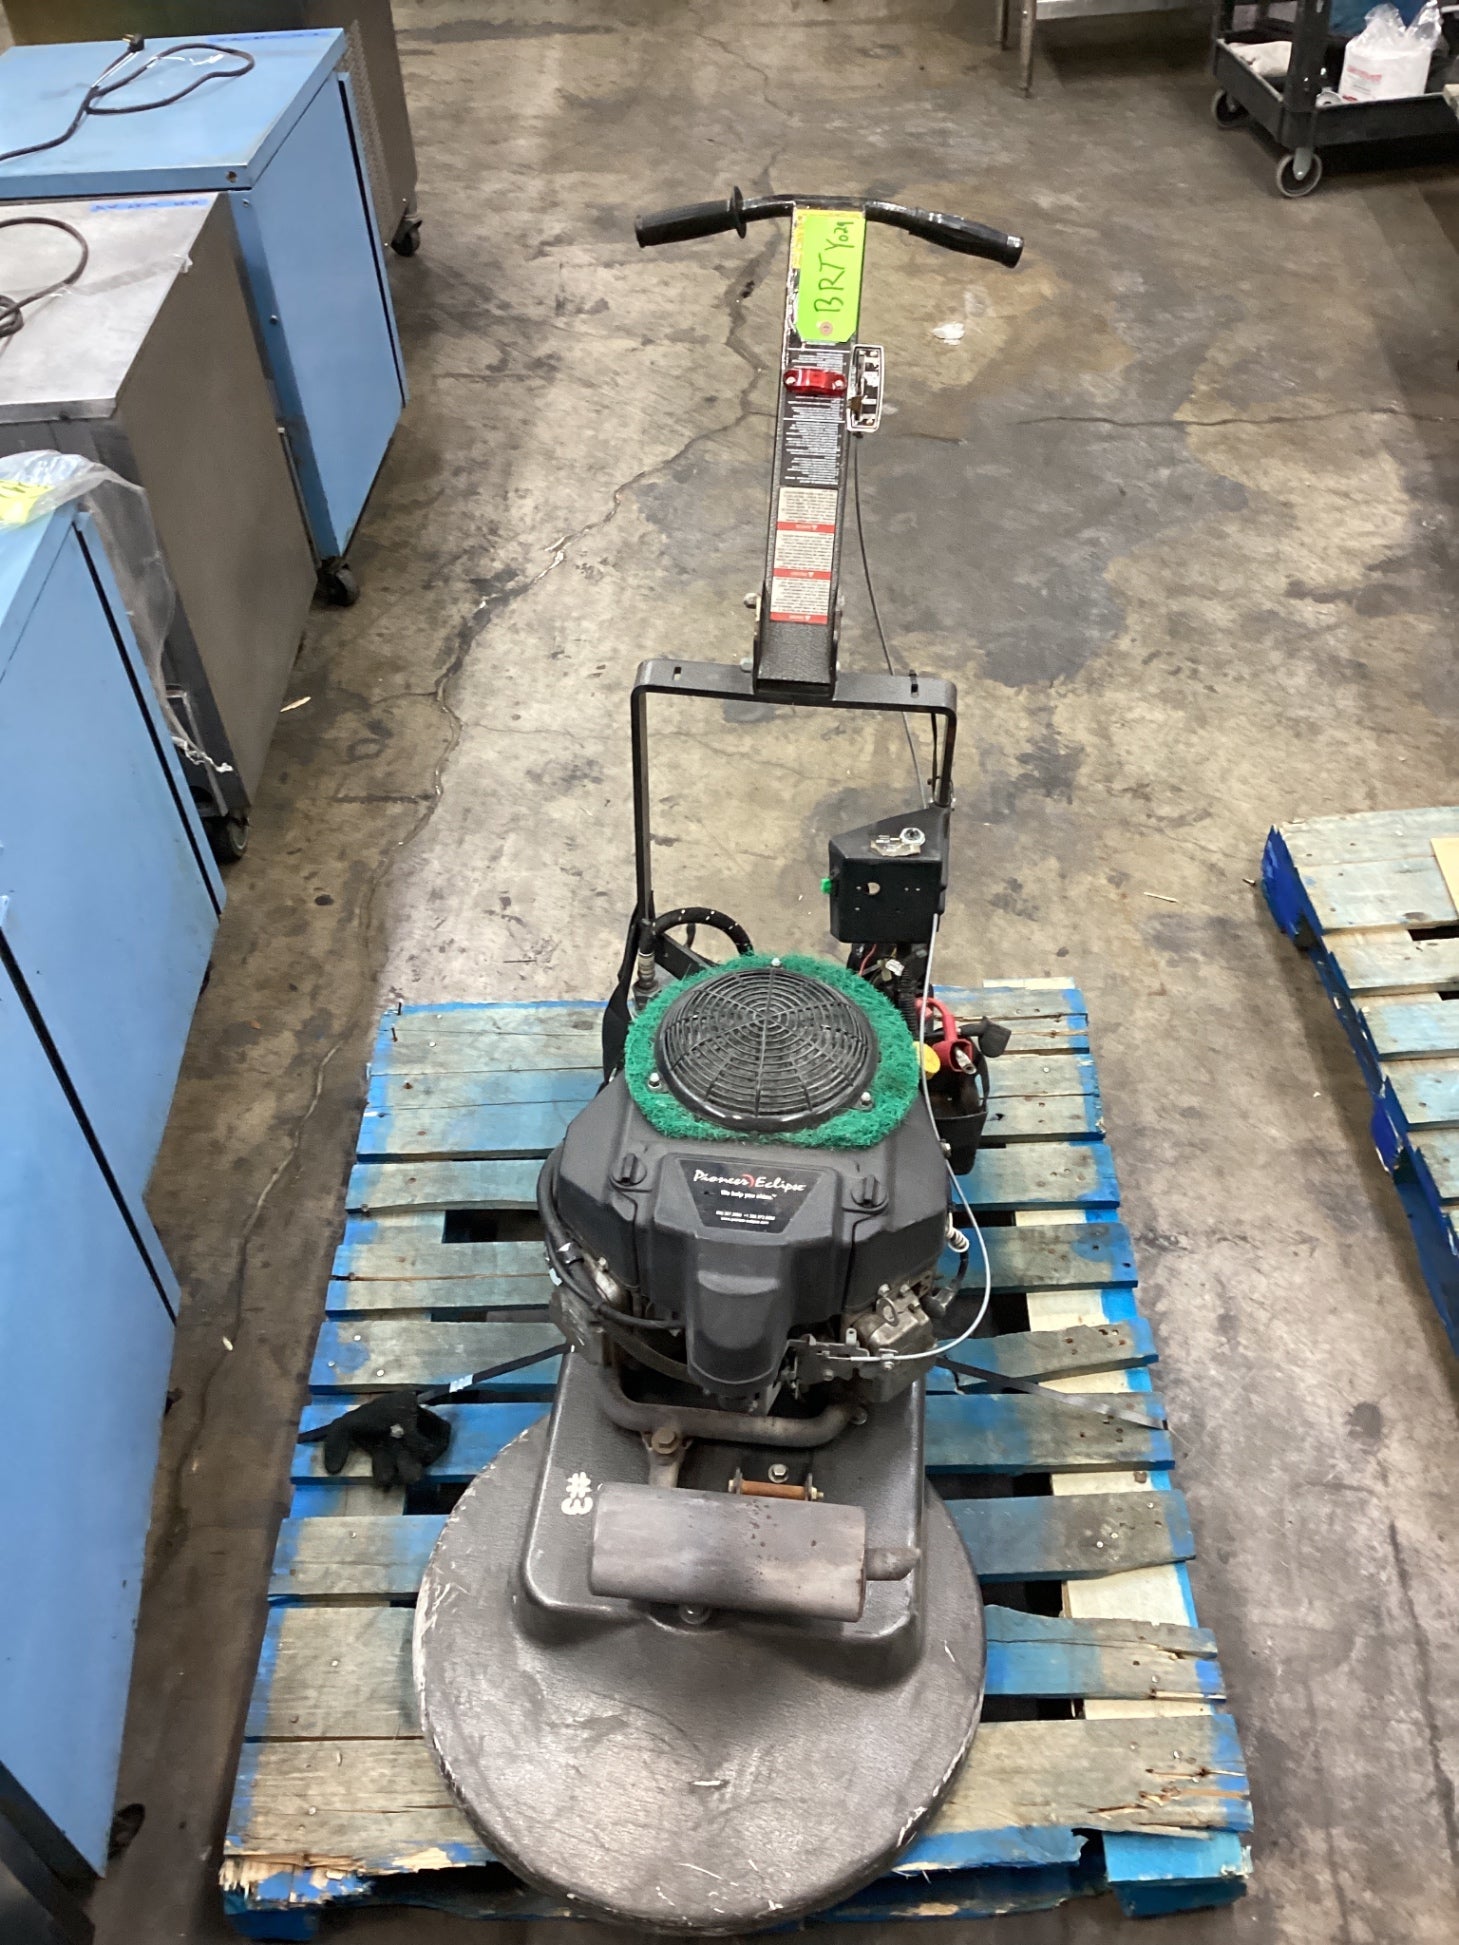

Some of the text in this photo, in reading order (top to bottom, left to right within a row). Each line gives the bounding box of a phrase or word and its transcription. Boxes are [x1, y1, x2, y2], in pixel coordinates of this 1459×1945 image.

[814, 253, 845, 312] BRT
[693, 1169, 806, 1192] Pioneer Eclipse
[561, 1471, 593, 1516] #3
